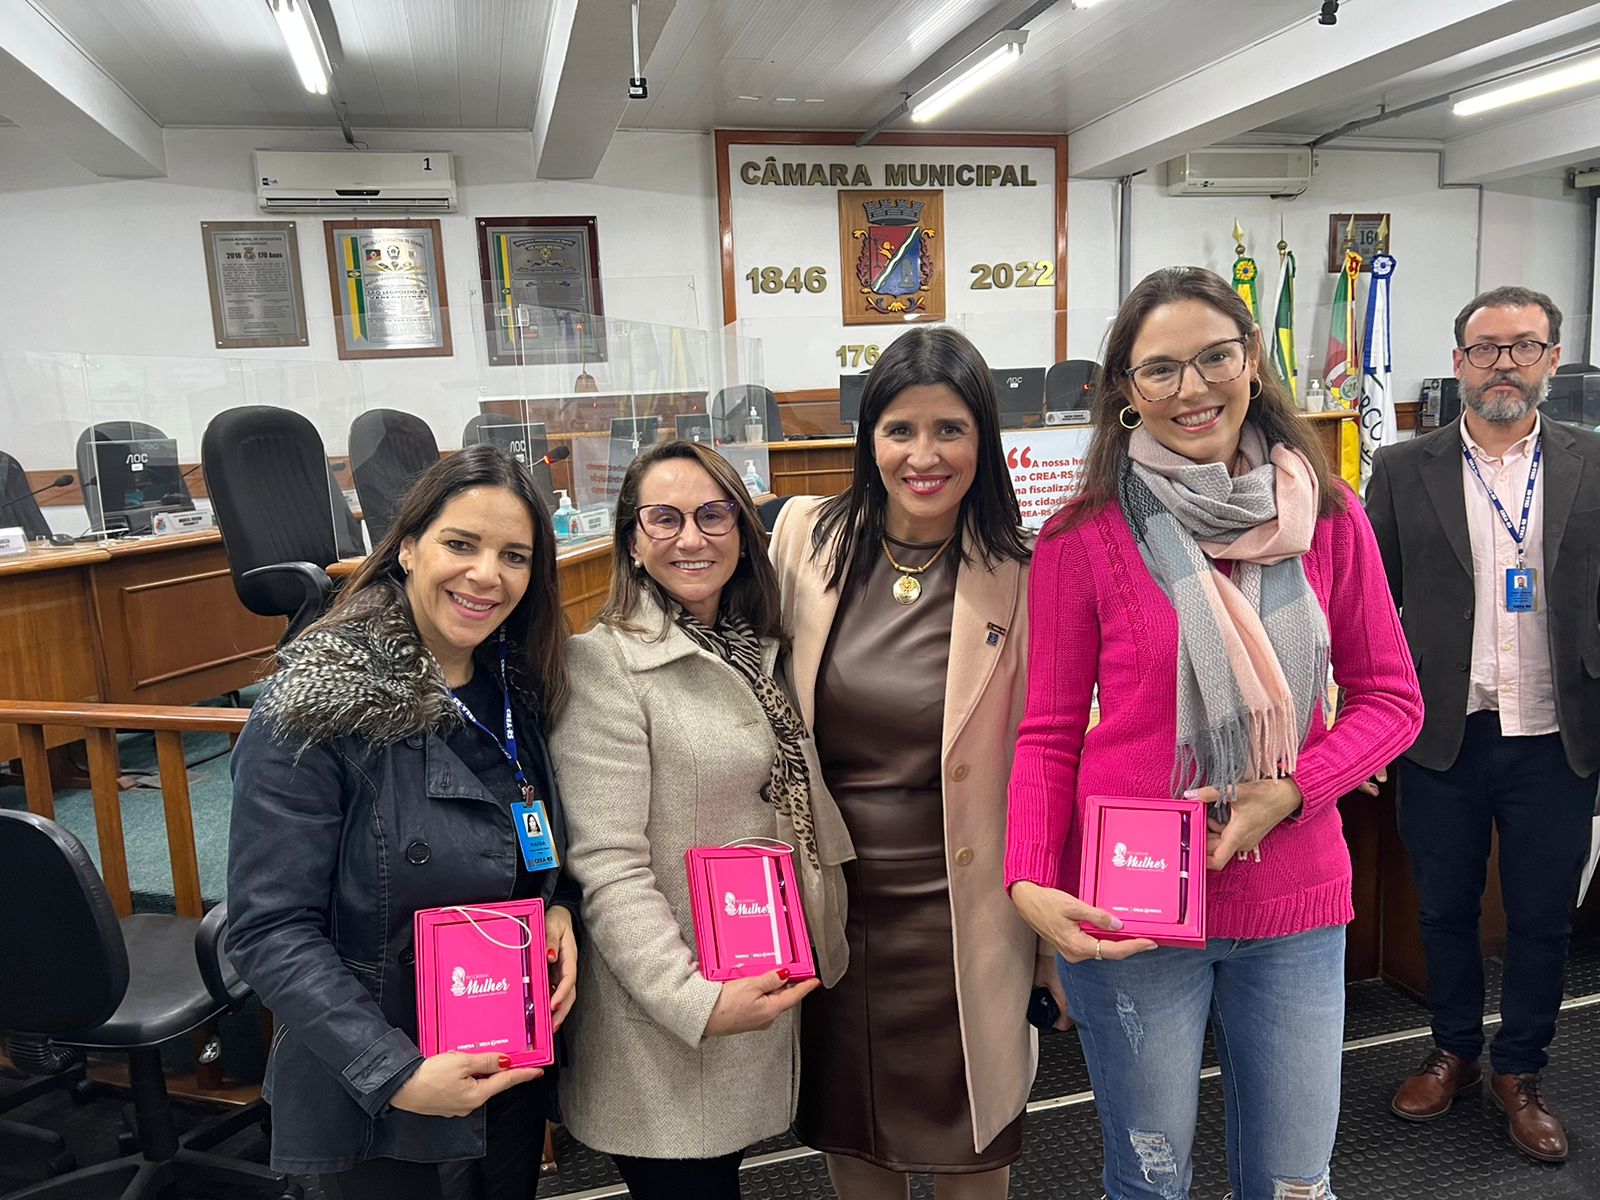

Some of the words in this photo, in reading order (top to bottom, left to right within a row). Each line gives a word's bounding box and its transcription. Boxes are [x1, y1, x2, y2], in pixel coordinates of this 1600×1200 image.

[423, 157, 432, 171] 1
[740, 156, 873, 187] CÂMARA
[885, 163, 1038, 188] MUNICIPAL
[745, 265, 828, 294] 1846
[970, 260, 1056, 290] 2022
[125, 453, 149, 464] AOC
[1042, 458, 1070, 468] nossa
[1014, 474, 1027, 482] ao
[1029, 470, 1074, 482] CREA-RS
[1015, 487, 1027, 495] na
[1021, 508, 1053, 518] REA-RS
[452, 696, 477, 723] CREA-RS
[506, 708, 515, 740] CREA-RS
[534, 856, 553, 864] CREA-RS
[1124, 855, 1169, 870] Mulher
[463, 978, 510, 995] Mulher
